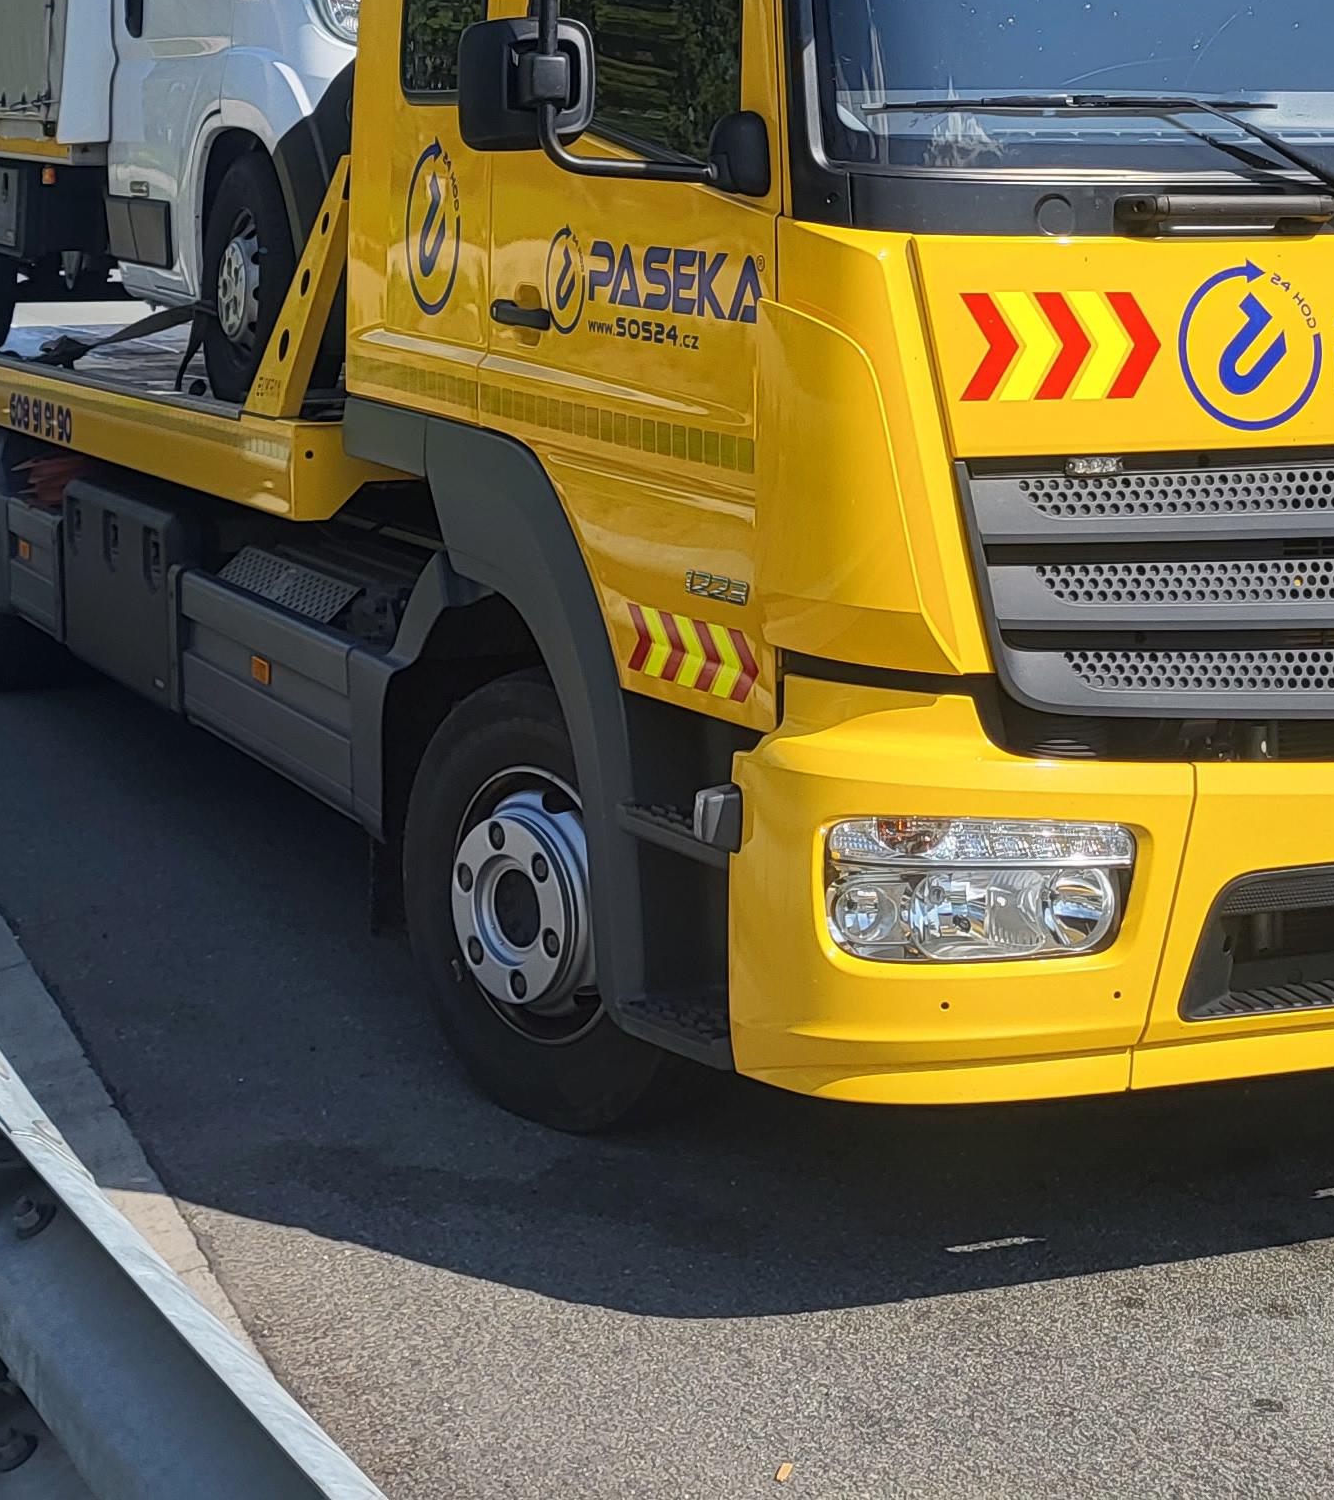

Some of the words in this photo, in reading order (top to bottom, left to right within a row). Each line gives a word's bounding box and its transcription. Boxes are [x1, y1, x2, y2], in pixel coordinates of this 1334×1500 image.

[1269, 272, 1292, 293] 24
[1292, 291, 1318, 330] HOD
[587, 316, 700, 350] www.SOS24.cz
[685, 569, 750, 606] 1223
